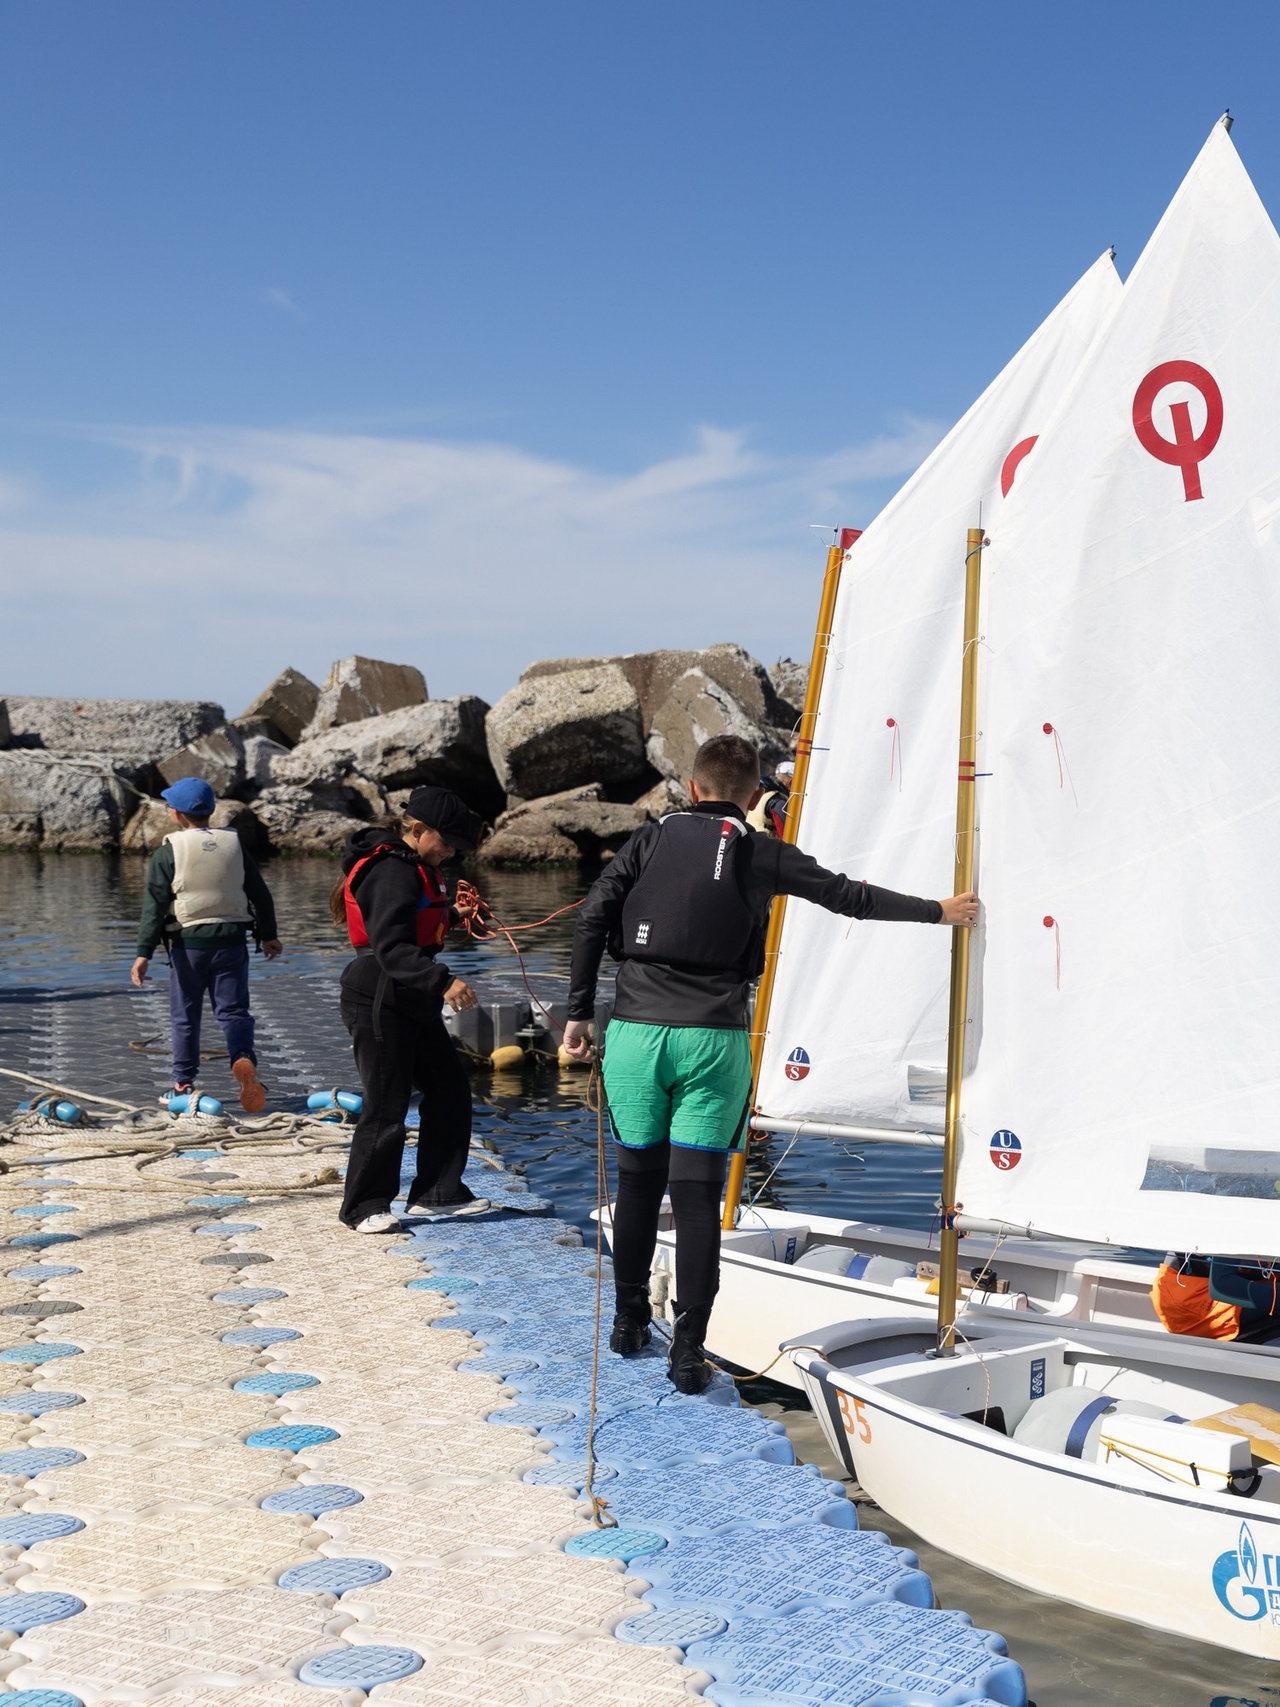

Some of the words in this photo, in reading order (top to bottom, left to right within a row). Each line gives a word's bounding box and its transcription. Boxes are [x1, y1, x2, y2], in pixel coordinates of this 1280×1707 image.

[713, 837, 727, 880] ROOSTER
[792, 1048, 804, 1062] U
[789, 1066, 800, 1080] S
[998, 1131, 1013, 1148] U
[998, 1152, 1011, 1169] S
[836, 1389, 872, 1445] 35
